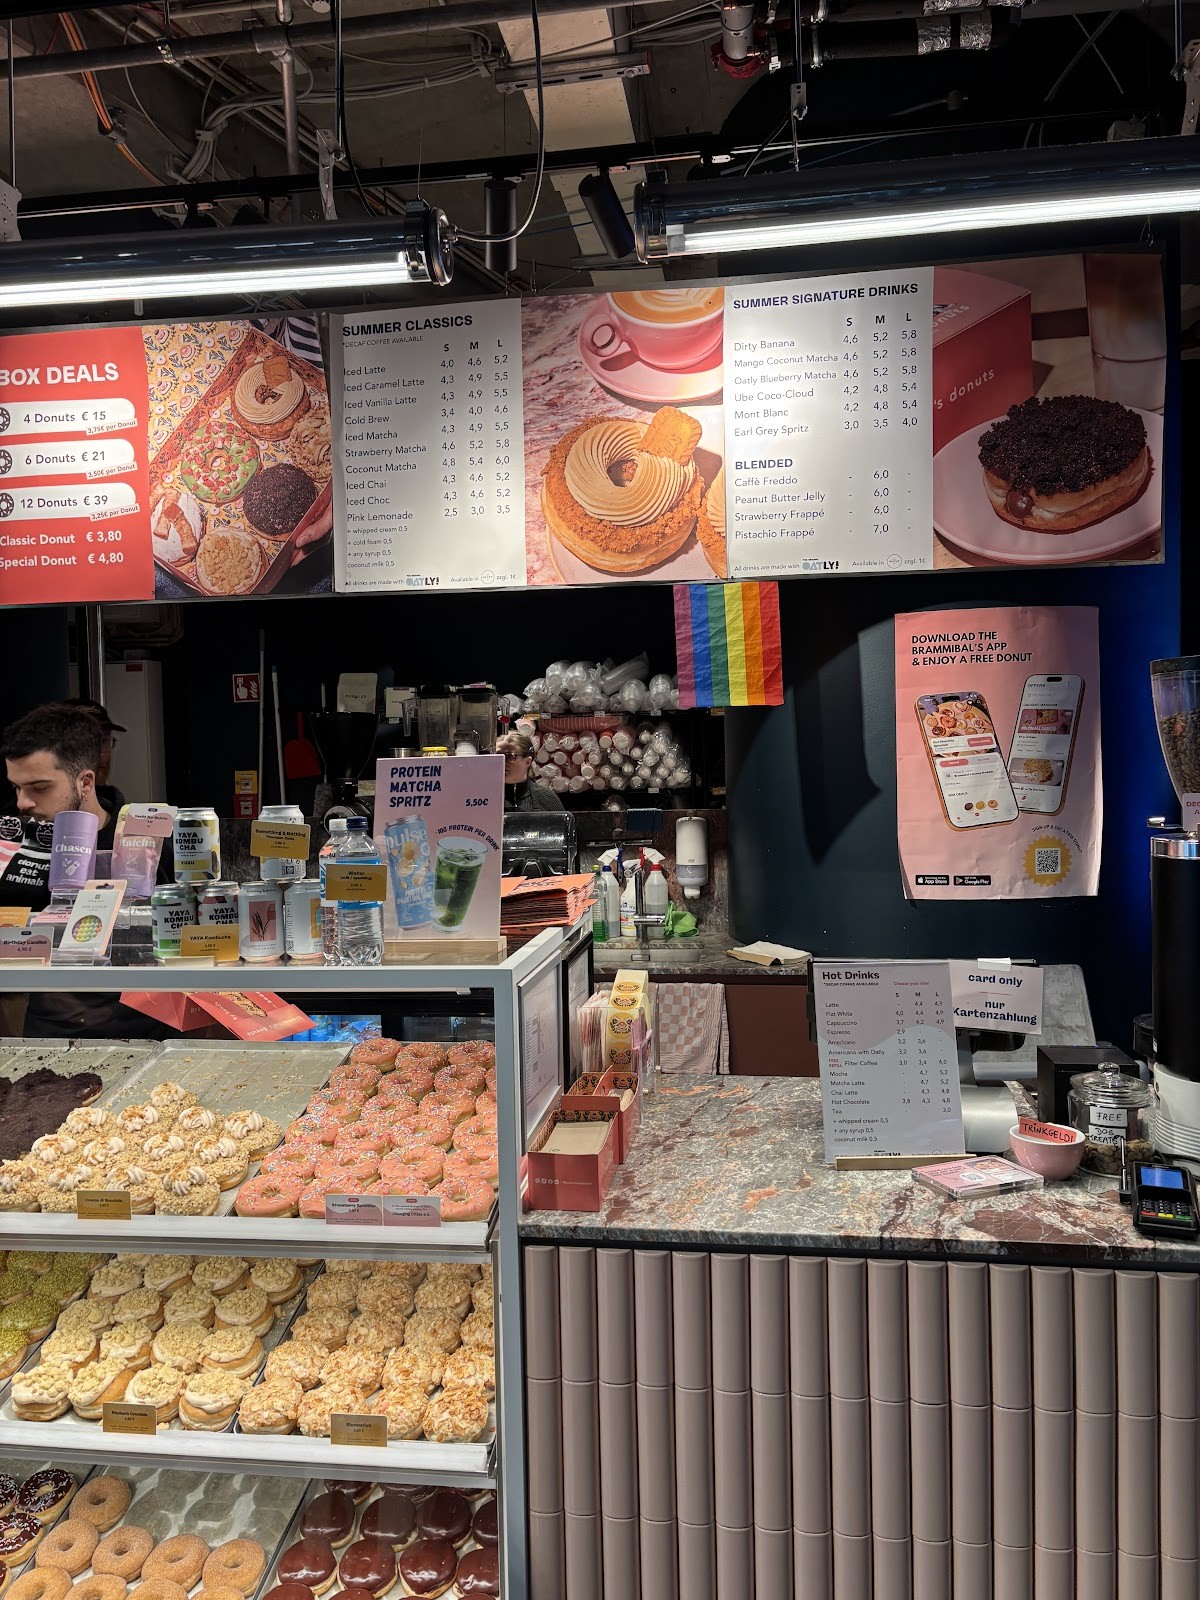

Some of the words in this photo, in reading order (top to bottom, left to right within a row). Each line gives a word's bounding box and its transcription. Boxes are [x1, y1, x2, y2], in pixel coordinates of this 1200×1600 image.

[733, 295, 789, 309] SUMMER
[792, 288, 865, 305] SIGNATURE
[868, 283, 918, 297] DRINKS
[342, 322, 401, 336] SUMMER
[405, 315, 473, 331] CLASSICS
[846, 317, 853, 326] S
[875, 315, 885, 324] M
[906, 313, 911, 321] L
[469, 342, 479, 350] M
[734, 341, 757, 352] Dirty
[760, 339, 795, 349] Banana
[843, 335, 858, 345] 4,6
[873, 332, 888, 342] 5,2
[901, 330, 917, 340] 5,8
[343, 367, 362, 376] Iced
[364, 365, 386, 375] Latte
[440, 359, 455, 369] 4,0
[467, 358, 482, 367] 4,6
[494, 355, 508, 364] 5,2
[734, 360, 764, 369] Mango
[767, 356, 803, 365] Coconut
[806, 354, 838, 363] Matcha
[0, 368, 41, 386] BOX
[47, 362, 120, 385] DEALS
[734, 376, 758, 385] Oatly
[760, 373, 801, 384] Blueberry
[804, 371, 837, 380] Matcha
[734, 393, 754, 402] Ube
[757, 388, 814, 401] Coco-Cloud
[843, 385, 859, 395] 4,2
[873, 384, 888, 394] 4,8
[901, 382, 917, 392] 5,4
[949, 369, 995, 402] donuts
[23, 414, 31, 423] 4
[35, 413, 75, 423] Donuts
[82, 411, 89, 421] €
[93, 411, 106, 420] 15
[344, 416, 366, 425] Cold
[368, 415, 390, 424] Brew
[441, 408, 455, 418] 3,4
[468, 406, 483, 416] 4,0
[494, 404, 509, 414] 4,6
[117, 420, 136, 428] Donut
[735, 427, 753, 437] Earl
[755, 426, 778, 437] Grey
[781, 424, 809, 435] Spritz
[844, 421, 859, 430] 3,0
[873, 419, 888, 429] 3,5
[902, 417, 918, 427] 4,0
[345, 447, 393, 457] Strawberry
[395, 444, 427, 454] Matcha
[441, 441, 456, 451] 4,6
[469, 440, 484, 449] 5,2
[496, 439, 510, 448] 5,8
[25, 455, 32, 465] 6
[36, 454, 76, 464] Donuts
[82, 452, 88, 461] €
[92, 451, 105, 461] 21
[735, 458, 793, 470] BLENDED
[735, 478, 760, 487] Caffè
[763, 476, 798, 485] Freddo
[873, 470, 889, 480] 6,0
[21, 499, 33, 508] 12
[37, 498, 78, 508] Donuts
[83, 496, 90, 505] €
[94, 495, 108, 505] 39
[347, 513, 365, 522] Pink
[367, 511, 413, 521] Lemonade
[444, 508, 458, 517] 2,5
[471, 506, 485, 516] 3,0
[496, 504, 511, 514] 3,5
[0, 535, 36, 546] Classic
[40, 534, 75, 544] Donut
[86, 532, 94, 542] €
[97, 530, 122, 543] 3,80
[735, 529, 777, 539] Pistachio
[780, 527, 815, 539] Frappé
[873, 524, 889, 534] 7,0
[0, 555, 38, 569] Special
[41, 555, 77, 566] Donut
[88, 553, 95, 564] €
[98, 552, 124, 565] 4,80
[802, 561, 839, 571] OATLY!
[405, 577, 440, 586] OATLY!
[912, 632, 975, 644] DOWNLOAD
[978, 631, 997, 640] THE
[912, 643, 984, 655] BRAMMIBAL'S
[986, 642, 1007, 651] APP
[912, 657, 920, 666] &
[923, 655, 957, 665] ENJOY
[959, 655, 968, 664] A
[970, 654, 994, 663] FREE
[996, 652, 1032, 662] DONUT
[390, 765, 442, 778] PROTEIN
[389, 780, 442, 793] MATCHA
[389, 795, 431, 808] SPRITZ
[465, 798, 489, 807] 5,50€
[386, 827, 427, 848] pulse
[448, 824, 475, 832] PROTEIN
[474, 828, 486, 838] PER
[485, 835, 500, 851] DRINK
[55, 843, 92, 855] Chasen
[20, 867, 38, 877] eat
[6, 874, 44, 886] animals
[164, 914, 194, 923] KOMBU
[209, 912, 239, 920] KOMBU
[822, 971, 842, 980] Hot
[845, 971, 880, 980] Drinks
[968, 974, 995, 984] card
[998, 976, 1023, 988] only
[985, 1001, 1005, 1009] nur
[1096, 1112, 1122, 1121] FREE
